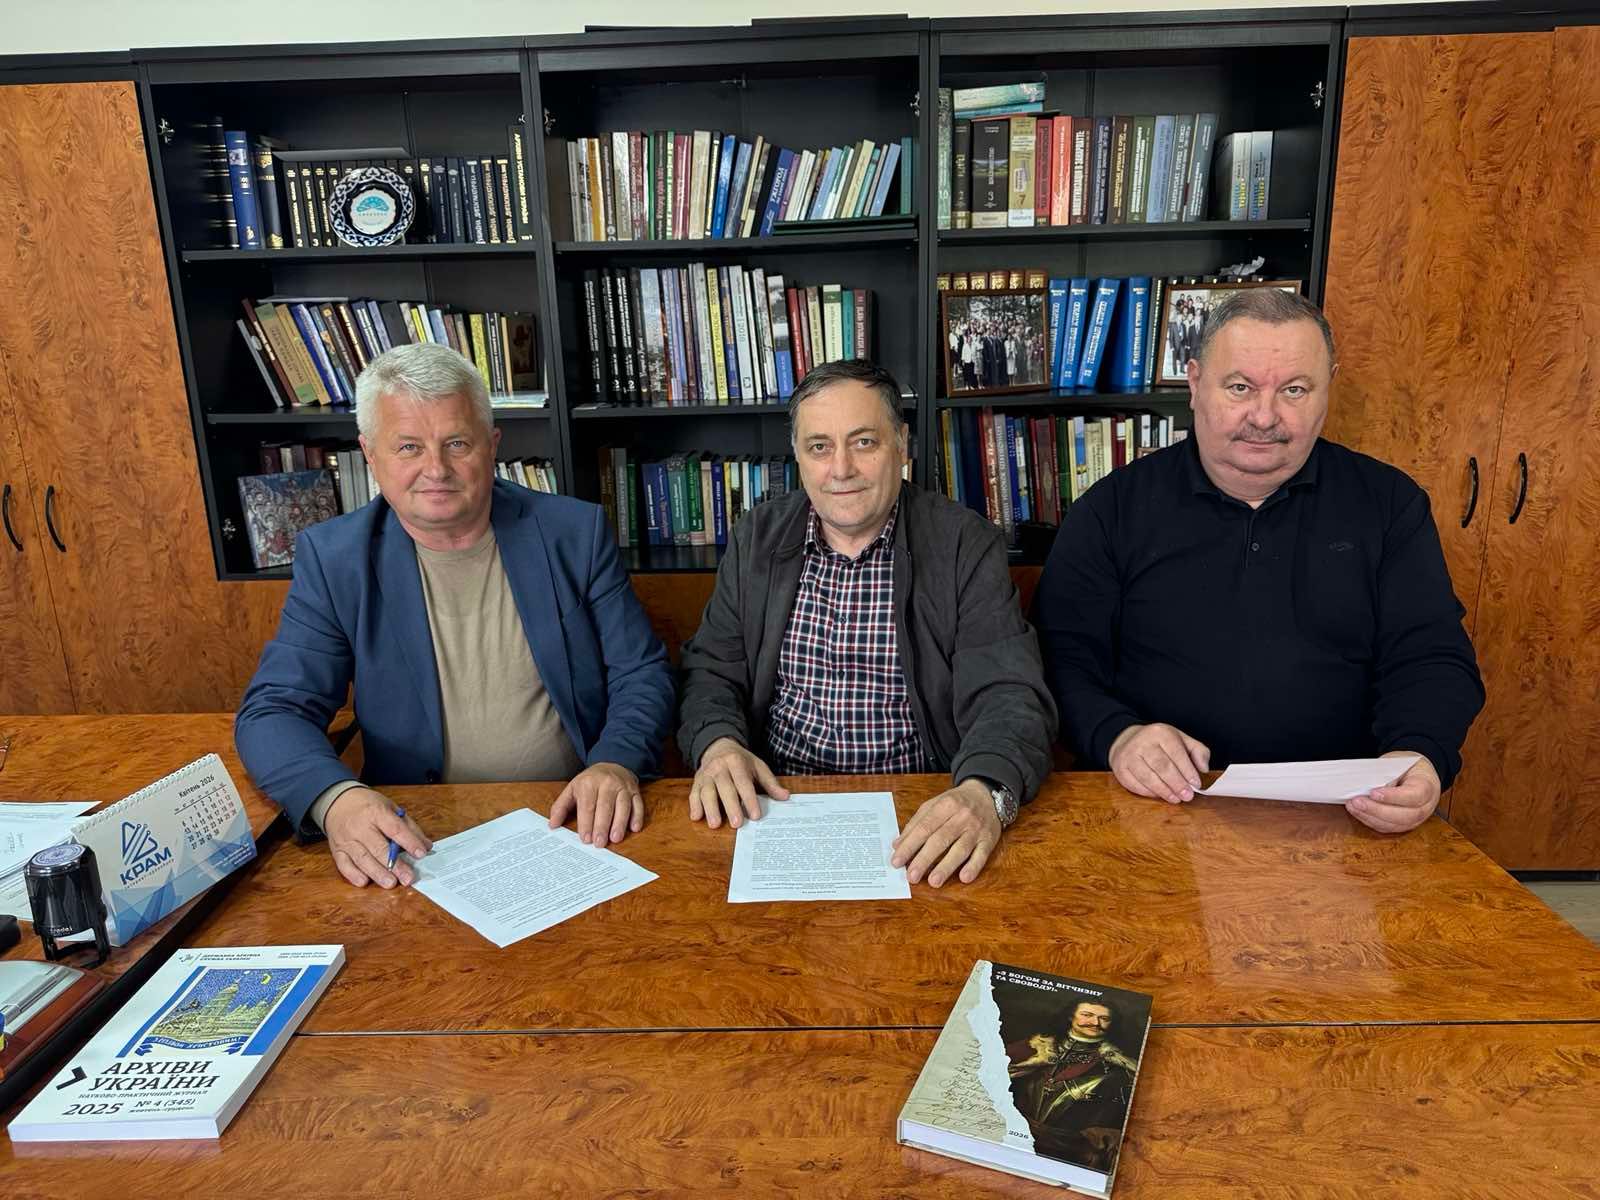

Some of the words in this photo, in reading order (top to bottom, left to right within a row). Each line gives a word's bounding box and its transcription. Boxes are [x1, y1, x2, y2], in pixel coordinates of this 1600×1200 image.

[179, 783, 201, 798] Квітень
[200, 774, 215, 787] 2026
[120, 847, 172, 885] КРАМ
[1008, 972, 1040, 984] БОГОМ
[1056, 983, 1103, 996] ВІТЧИЗНУ
[100, 1061, 214, 1075] АРХІВИ
[88, 1074, 220, 1091] УКРАЇНИ
[62, 1102, 124, 1116] 2025
[164, 1098, 196, 1107] (345)
[1008, 1130, 1029, 1139] 2026
